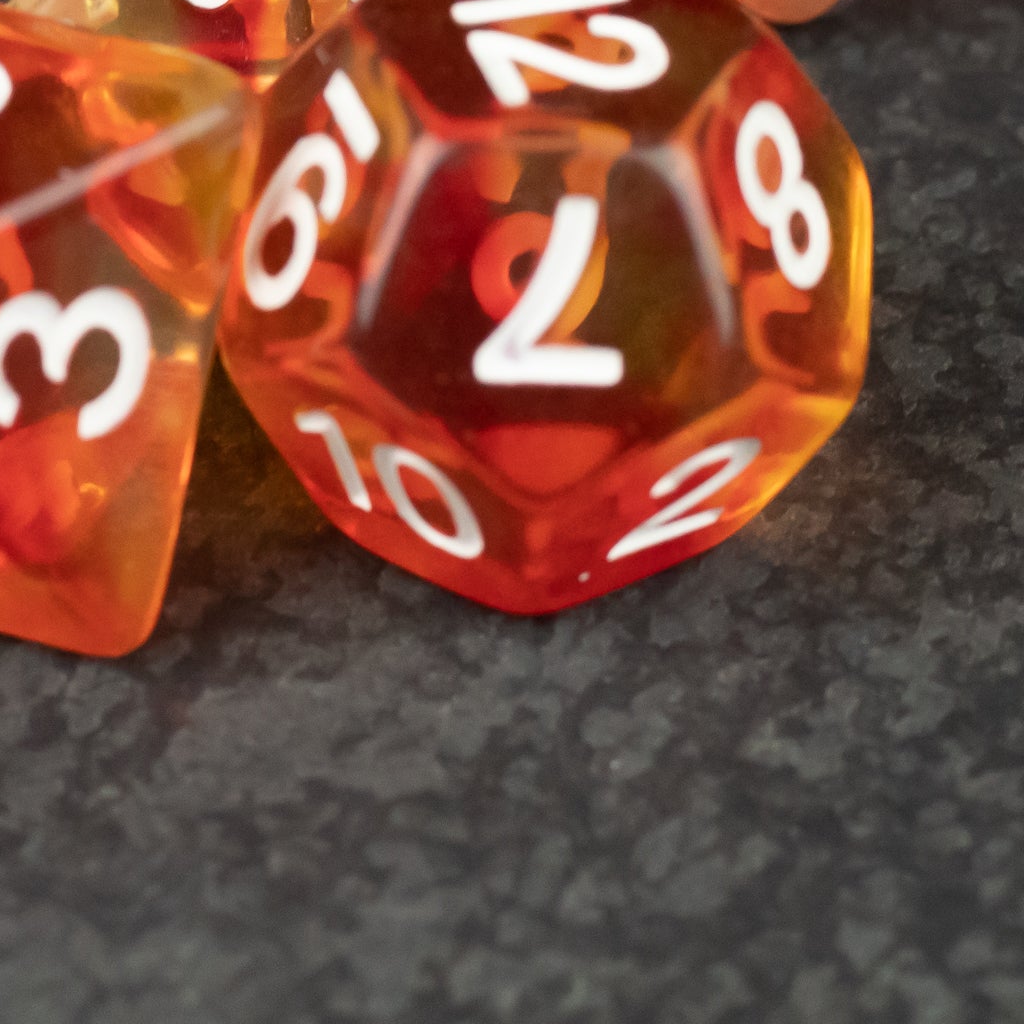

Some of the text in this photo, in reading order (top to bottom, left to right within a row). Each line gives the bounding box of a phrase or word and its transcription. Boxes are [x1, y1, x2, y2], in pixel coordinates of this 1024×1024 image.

[735, 100, 831, 290] 8
[472, 194, 624, 387] 7
[294, 410, 484, 559] 10
[605, 438, 763, 562] 2
